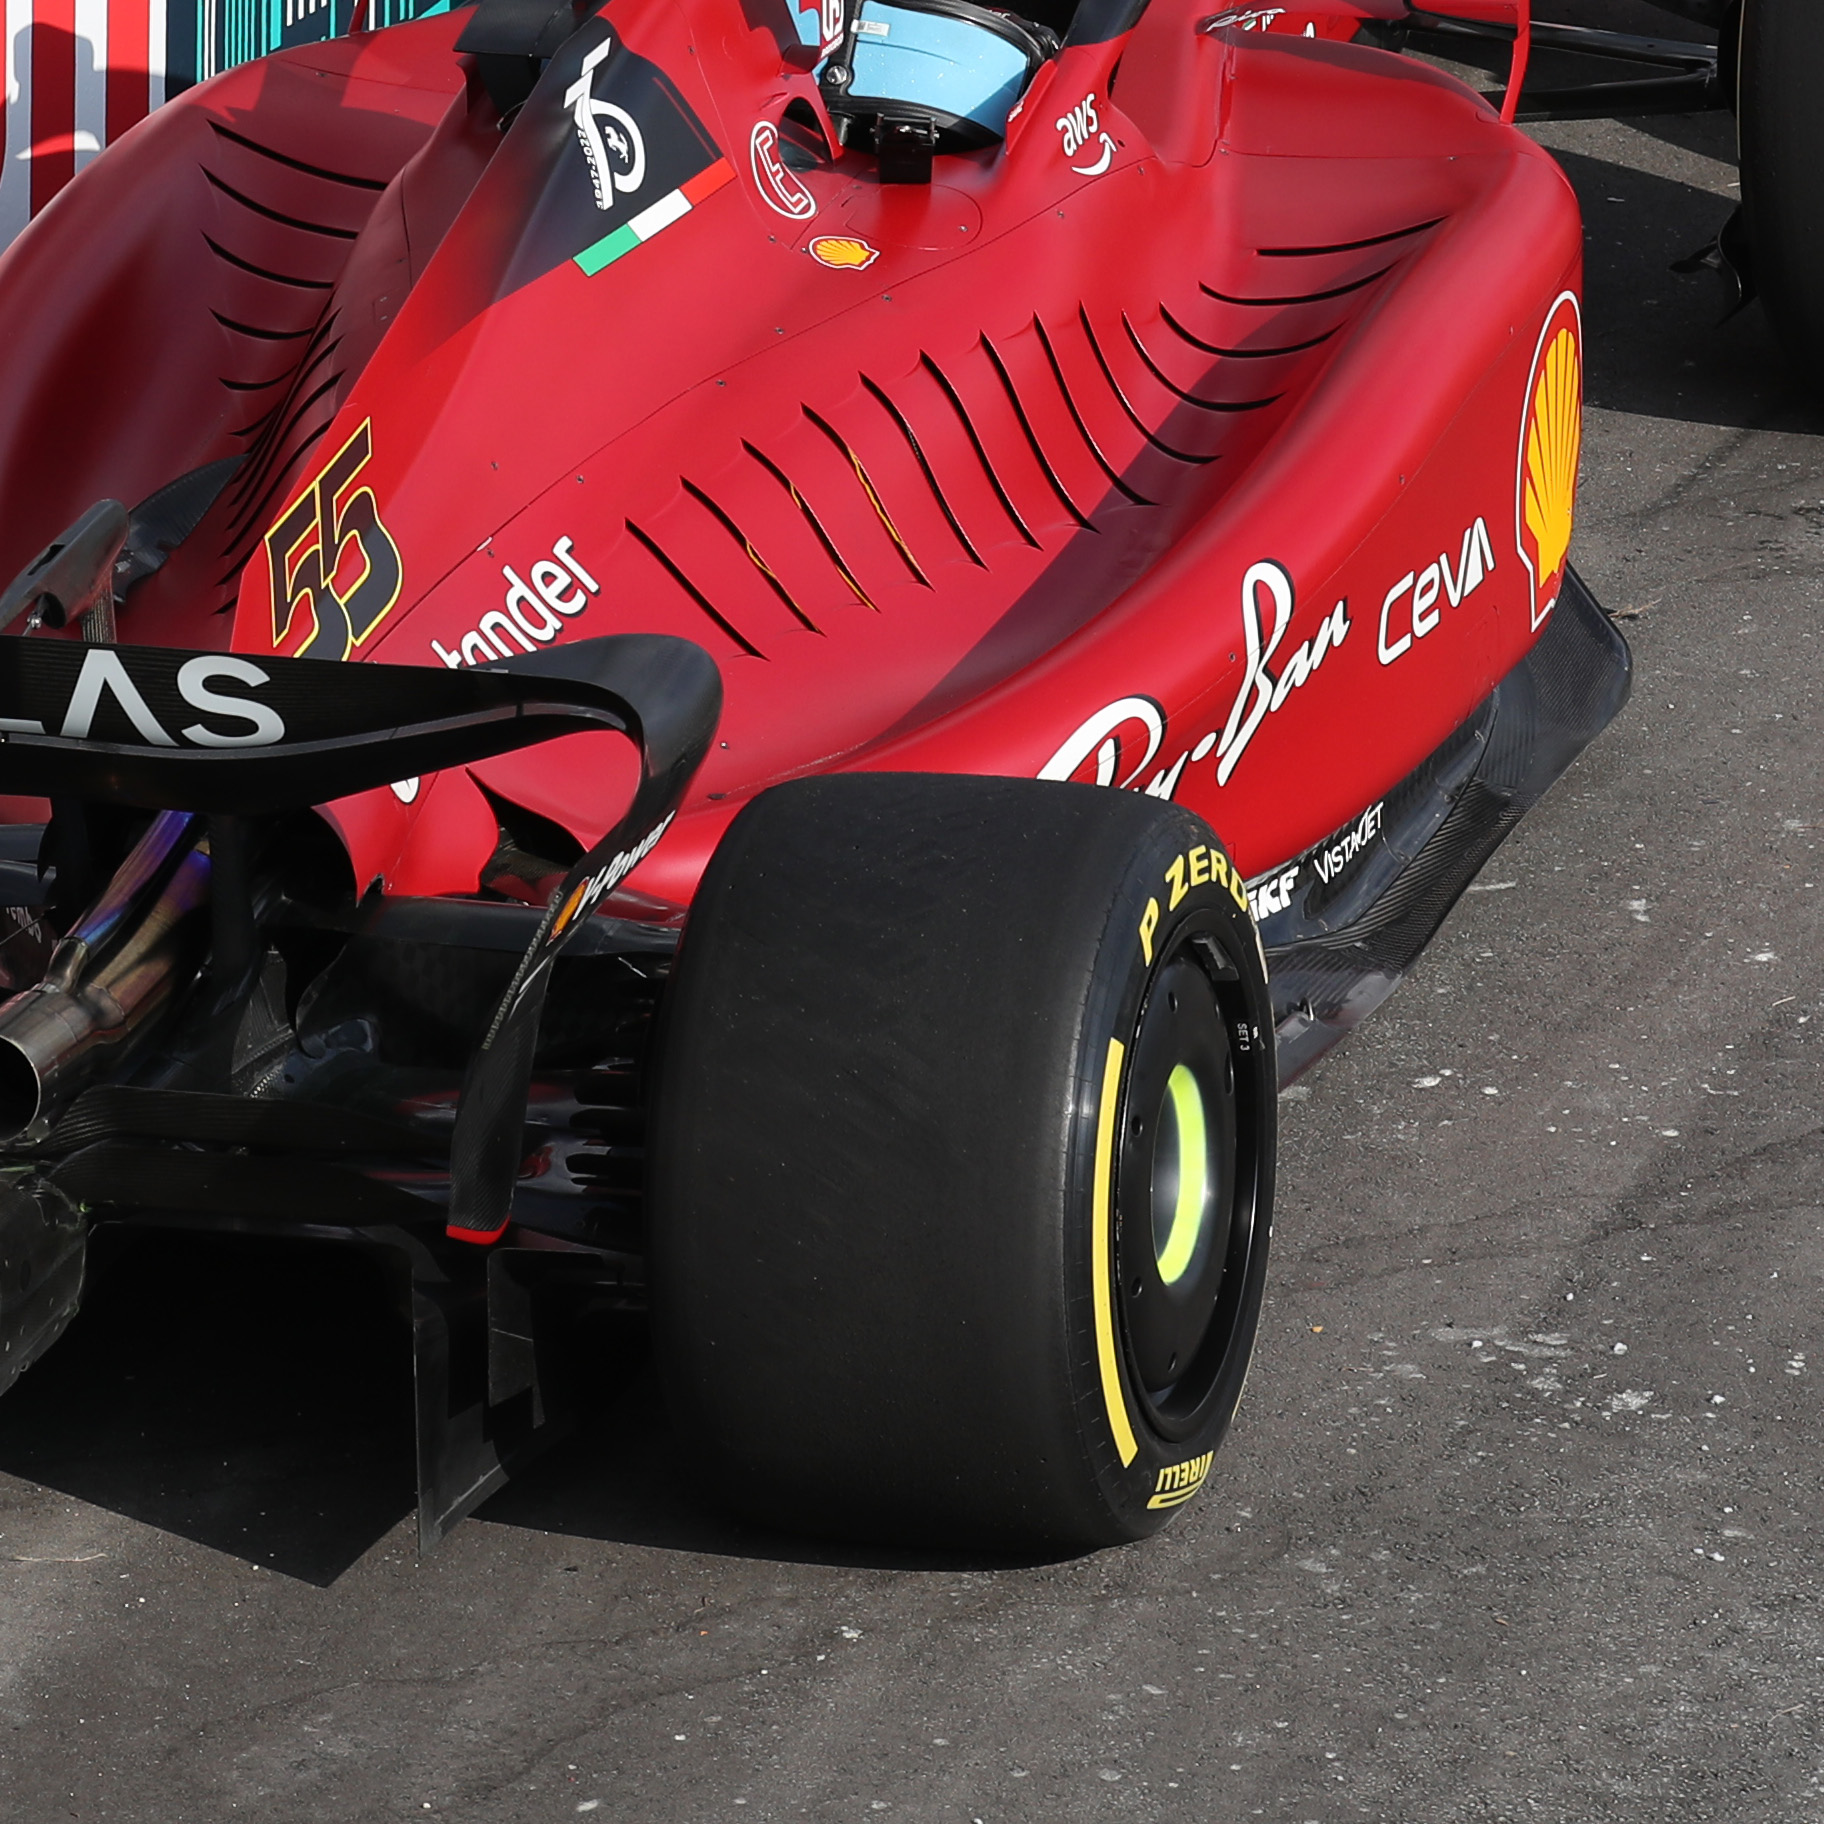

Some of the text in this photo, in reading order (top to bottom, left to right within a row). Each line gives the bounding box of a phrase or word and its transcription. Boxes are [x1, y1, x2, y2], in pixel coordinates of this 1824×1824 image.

[1056, 92, 1099, 157] aws
[265, 416, 404, 662] 55
[1139, 844, 1249, 967] P ZERO
[1237, 1022, 1250, 1044] SET
